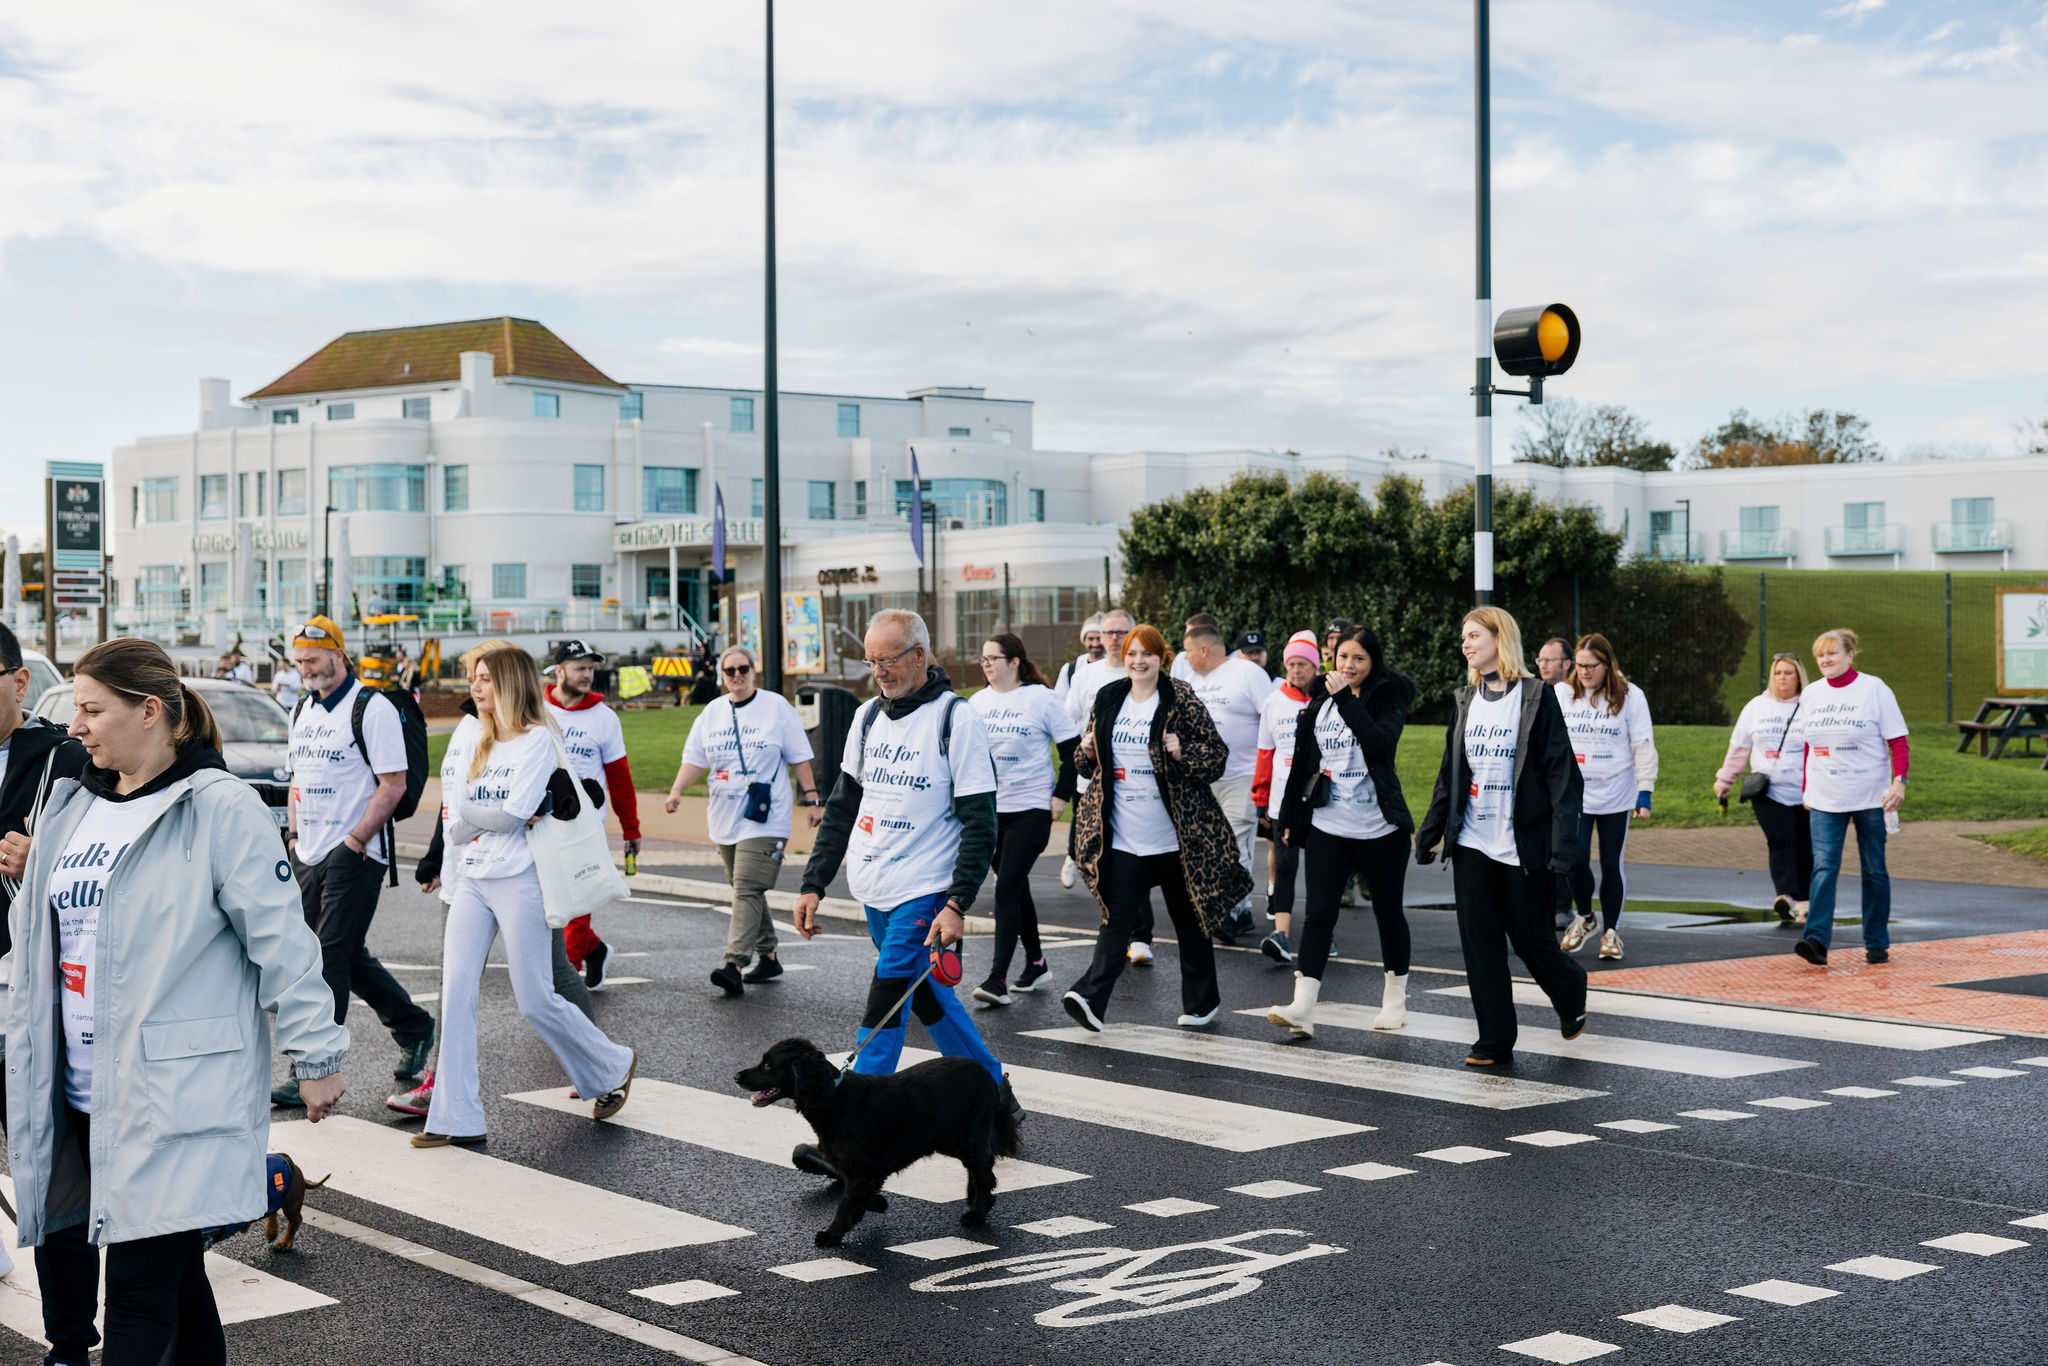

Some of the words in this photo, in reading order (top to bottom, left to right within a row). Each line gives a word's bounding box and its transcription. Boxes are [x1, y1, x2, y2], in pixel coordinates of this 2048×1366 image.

[313, 724, 336, 740] for
[987, 723, 1032, 737] lbeing.
[1464, 724, 1487, 738] alk
[1488, 724, 1513, 740] for
[1569, 723, 1621, 737] ellbeing.
[891, 744, 920, 765] for
[1465, 744, 1517, 761] ellbeing
[879, 819, 915, 831] mum.
[54, 842, 110, 873] alk
